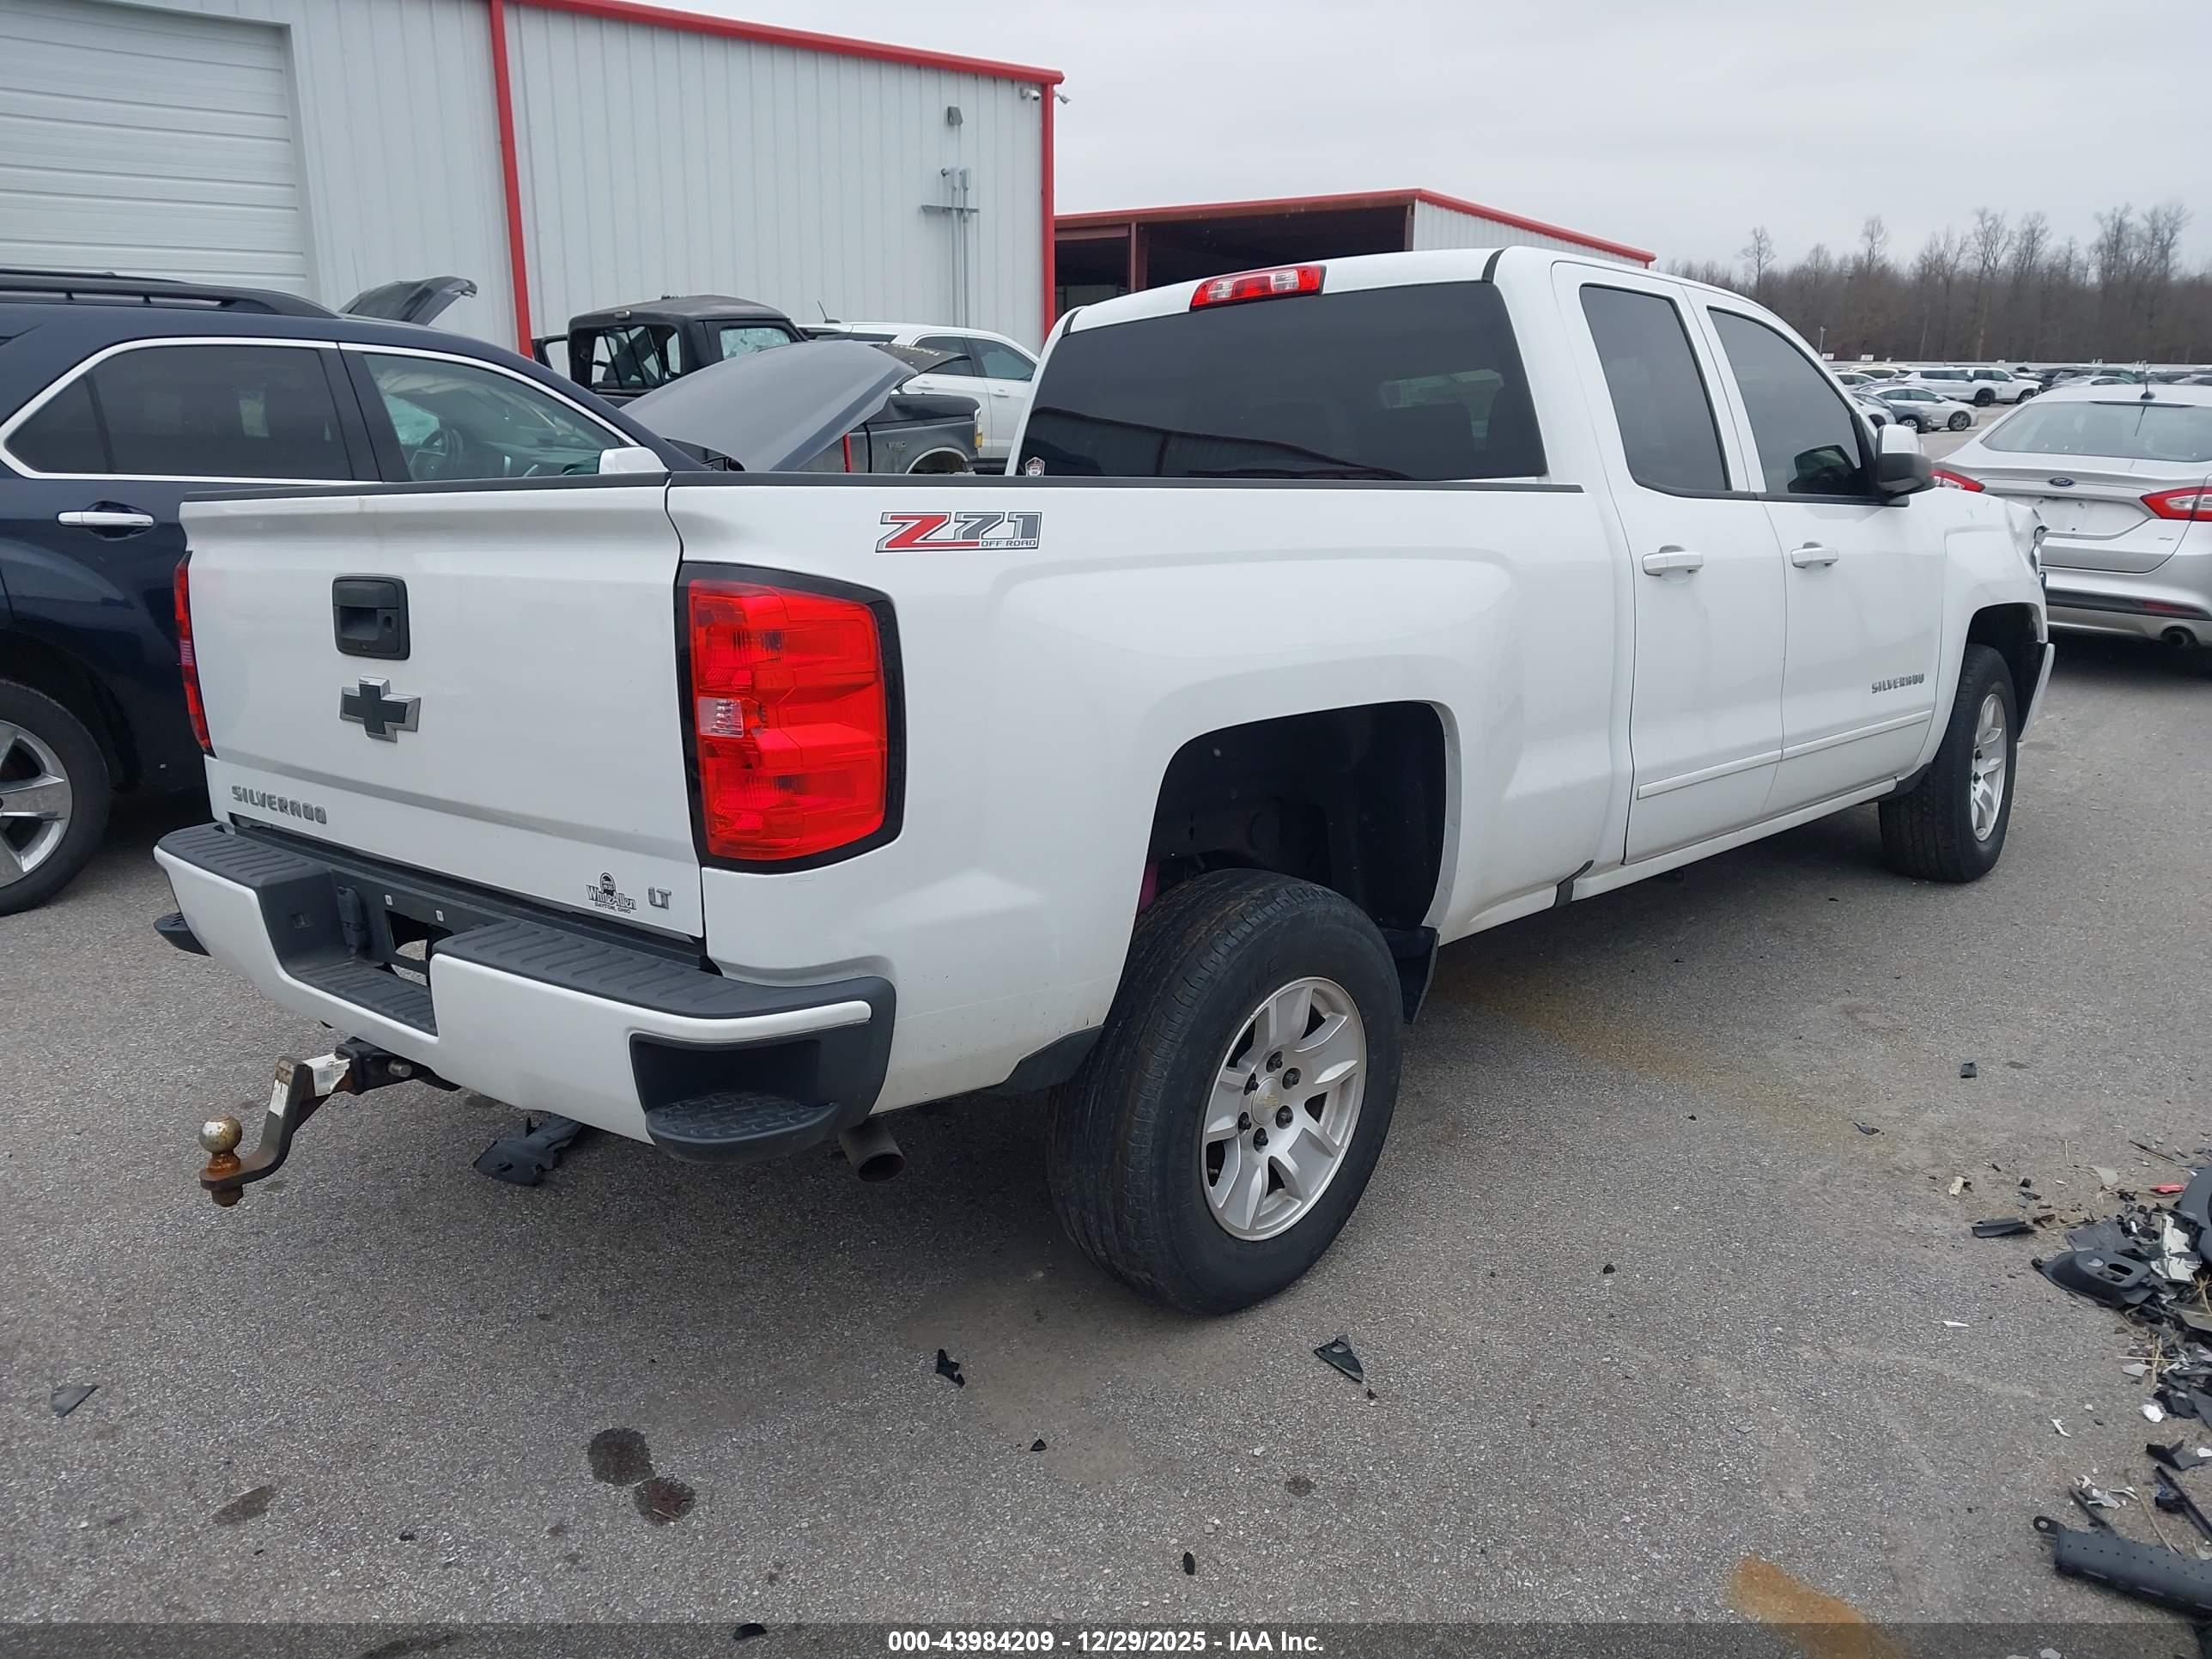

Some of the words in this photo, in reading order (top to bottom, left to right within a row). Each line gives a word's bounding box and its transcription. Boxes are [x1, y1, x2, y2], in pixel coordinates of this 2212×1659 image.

[875, 512, 1042, 553] Z71
[1006, 538, 1037, 547] ROAD
[1871, 673, 1924, 694] SILVERADO
[231, 785, 327, 824] SILVERADO
[647, 887, 672, 909] LT
